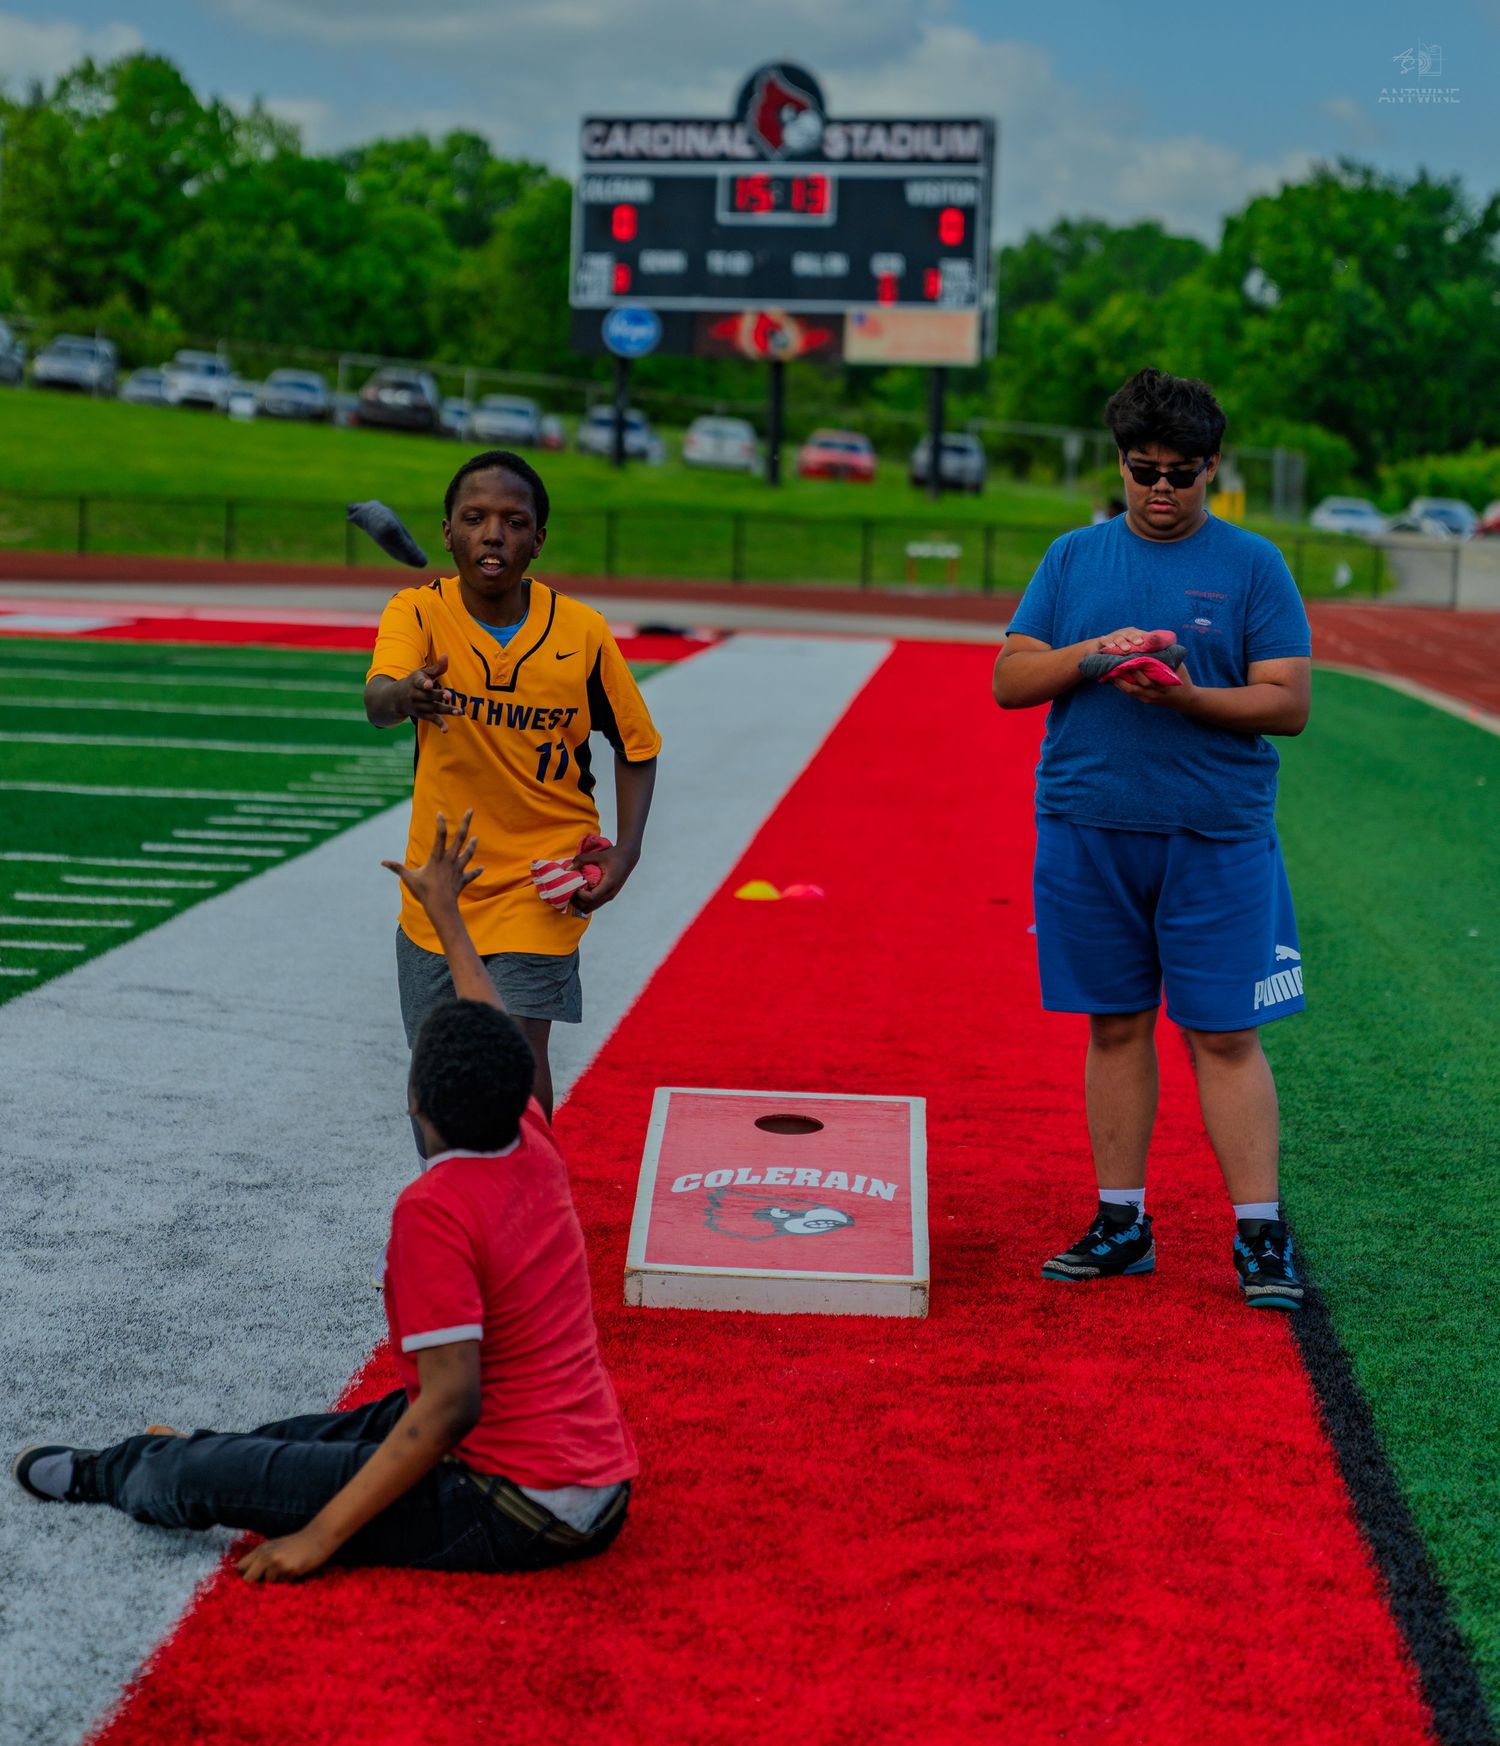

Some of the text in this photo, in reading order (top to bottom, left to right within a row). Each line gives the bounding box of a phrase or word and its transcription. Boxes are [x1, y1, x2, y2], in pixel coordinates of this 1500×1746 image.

[582, 121, 981, 160] CARDINAL STADIUM
[434, 681, 579, 731] RTHWEST
[535, 738, 570, 784] 11
[671, 1167, 898, 1201] COLERAIN
